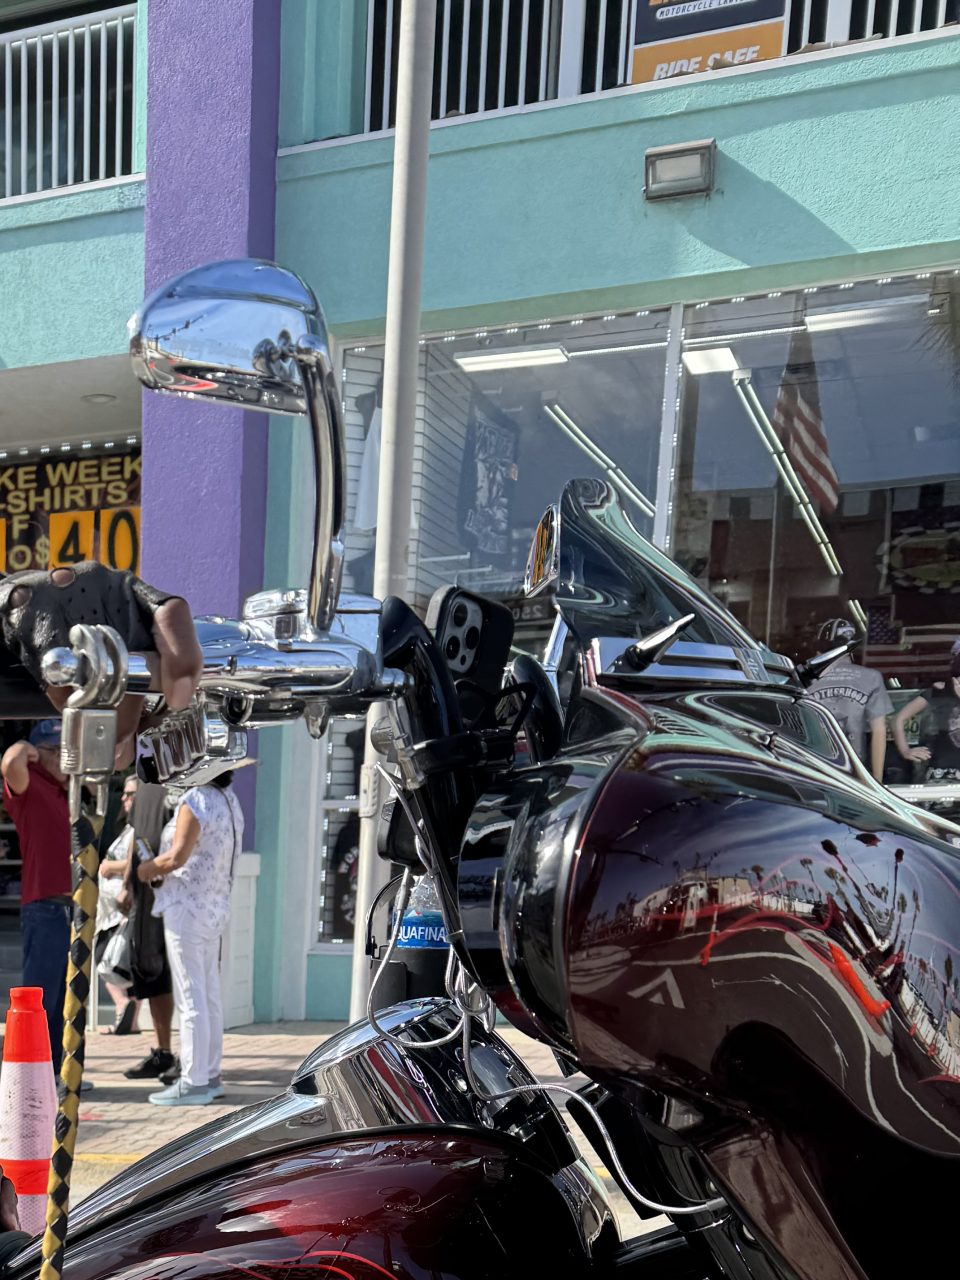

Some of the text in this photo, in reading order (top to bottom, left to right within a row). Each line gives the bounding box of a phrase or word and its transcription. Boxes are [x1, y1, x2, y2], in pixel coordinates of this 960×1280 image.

[659, 0, 713, 17] MOTORCYCLE
[45, 456, 141, 487] WEEK
[809, 686, 869, 705] OTHERHOOD
[396, 925, 448, 943] QUAFINA
